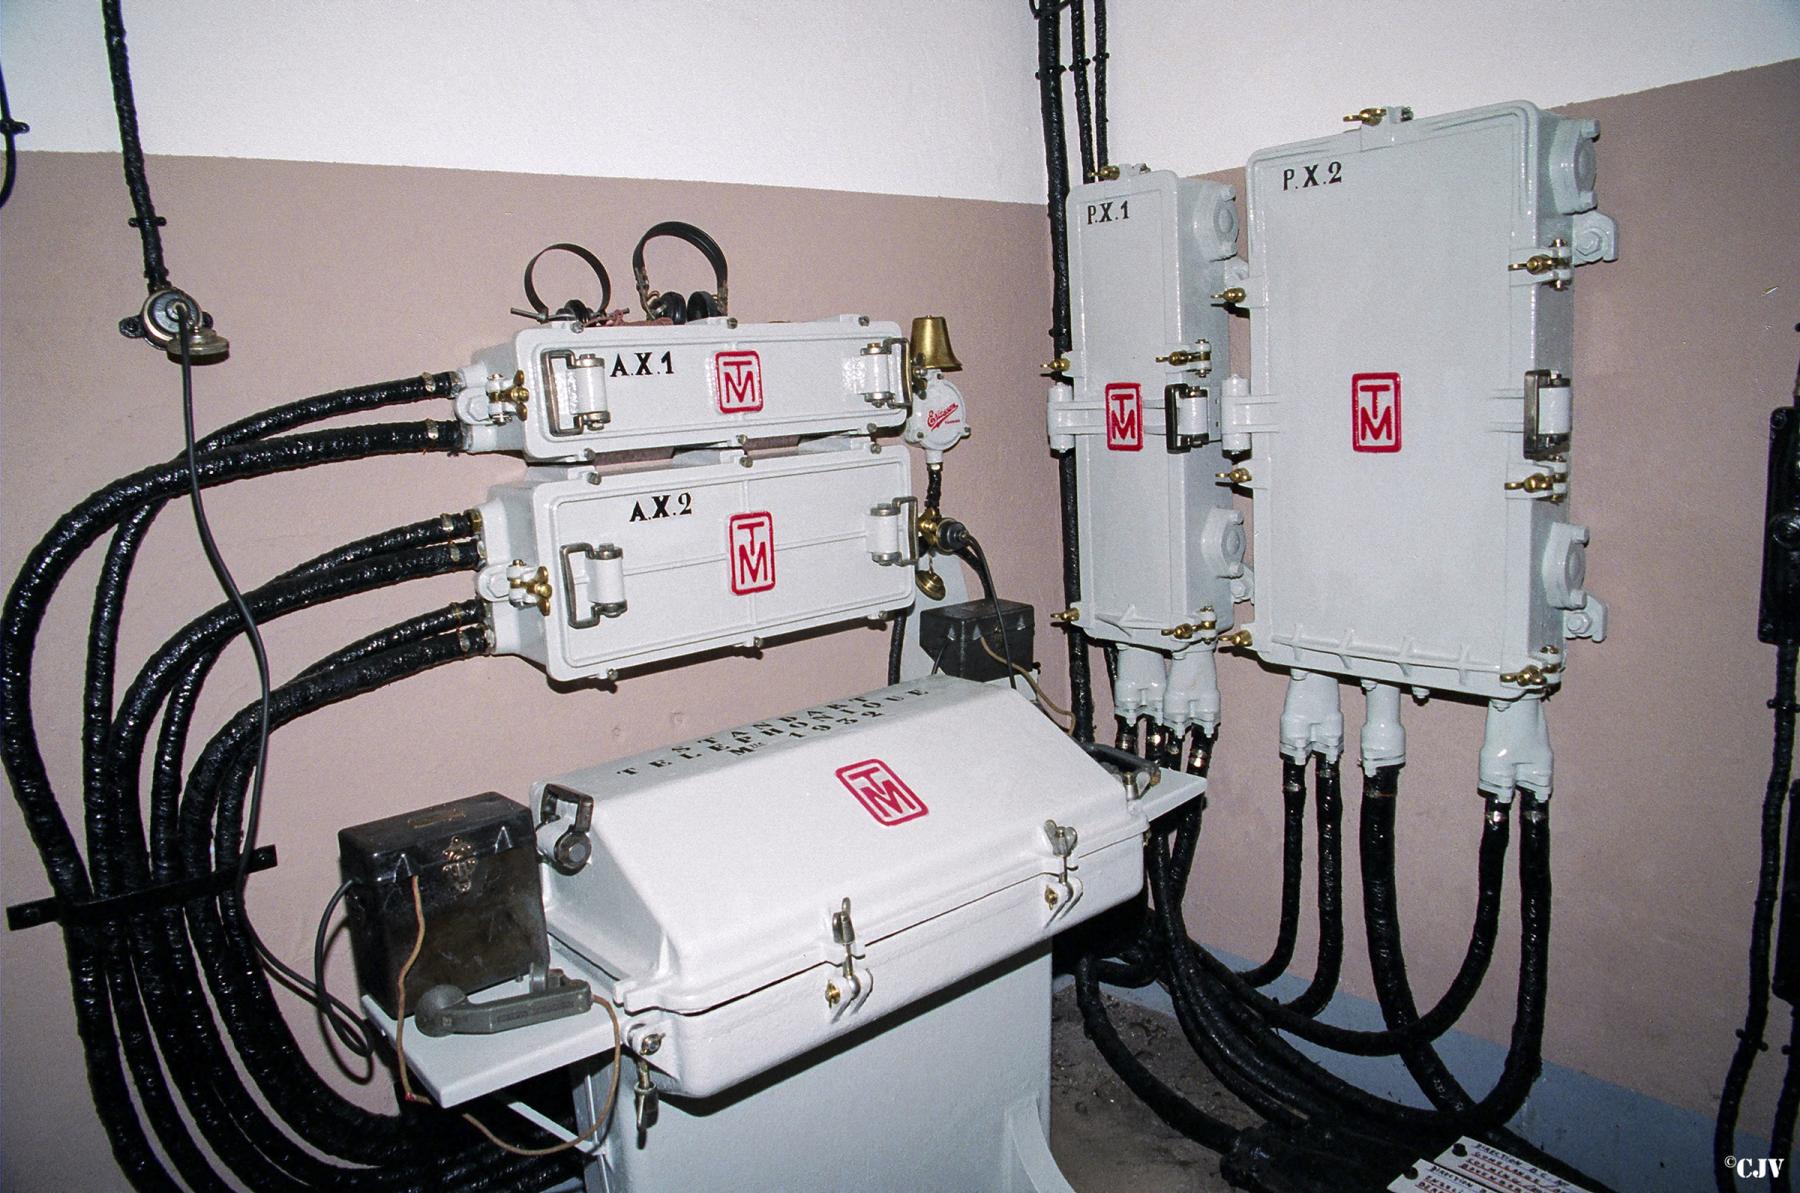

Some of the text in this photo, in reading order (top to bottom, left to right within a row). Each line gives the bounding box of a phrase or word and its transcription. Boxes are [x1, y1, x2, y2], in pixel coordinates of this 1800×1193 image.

[1283, 161, 1342, 191] P.X.2
[1087, 199, 1130, 225] P.X.1
[610, 350, 674, 379] A.X.1
[629, 492, 693, 523] A.X.2
[616, 688, 929, 775] TELEPHONIQUE
[788, 710, 885, 739] 1932
